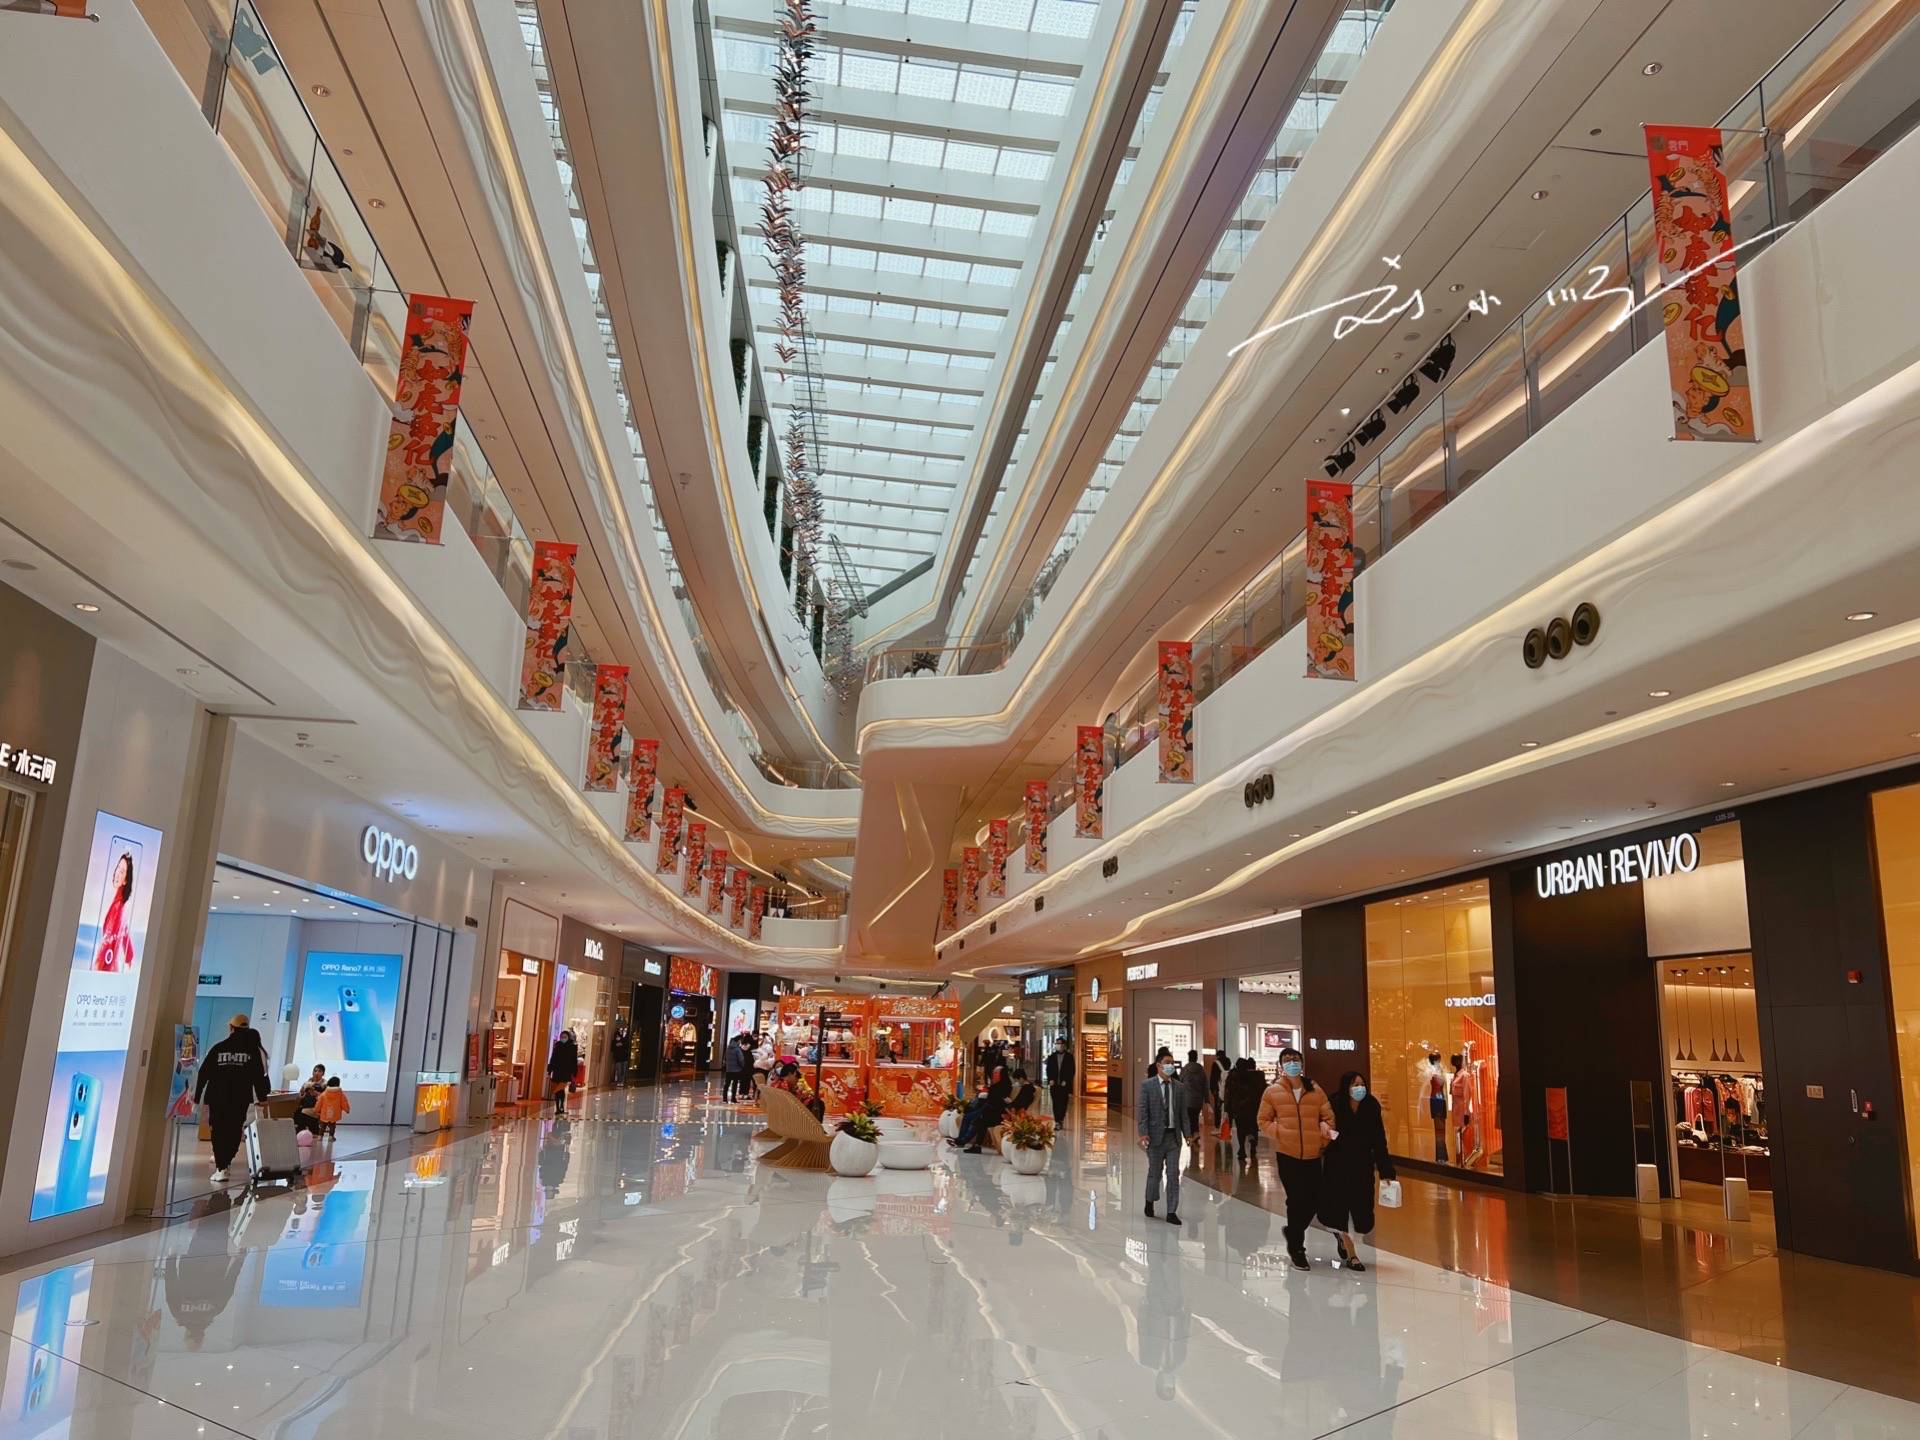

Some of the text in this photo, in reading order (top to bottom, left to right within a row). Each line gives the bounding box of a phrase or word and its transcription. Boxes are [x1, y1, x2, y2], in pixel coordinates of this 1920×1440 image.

[1536, 832, 1698, 899] URBAN REVIVO
[321, 963, 340, 972] OPPO
